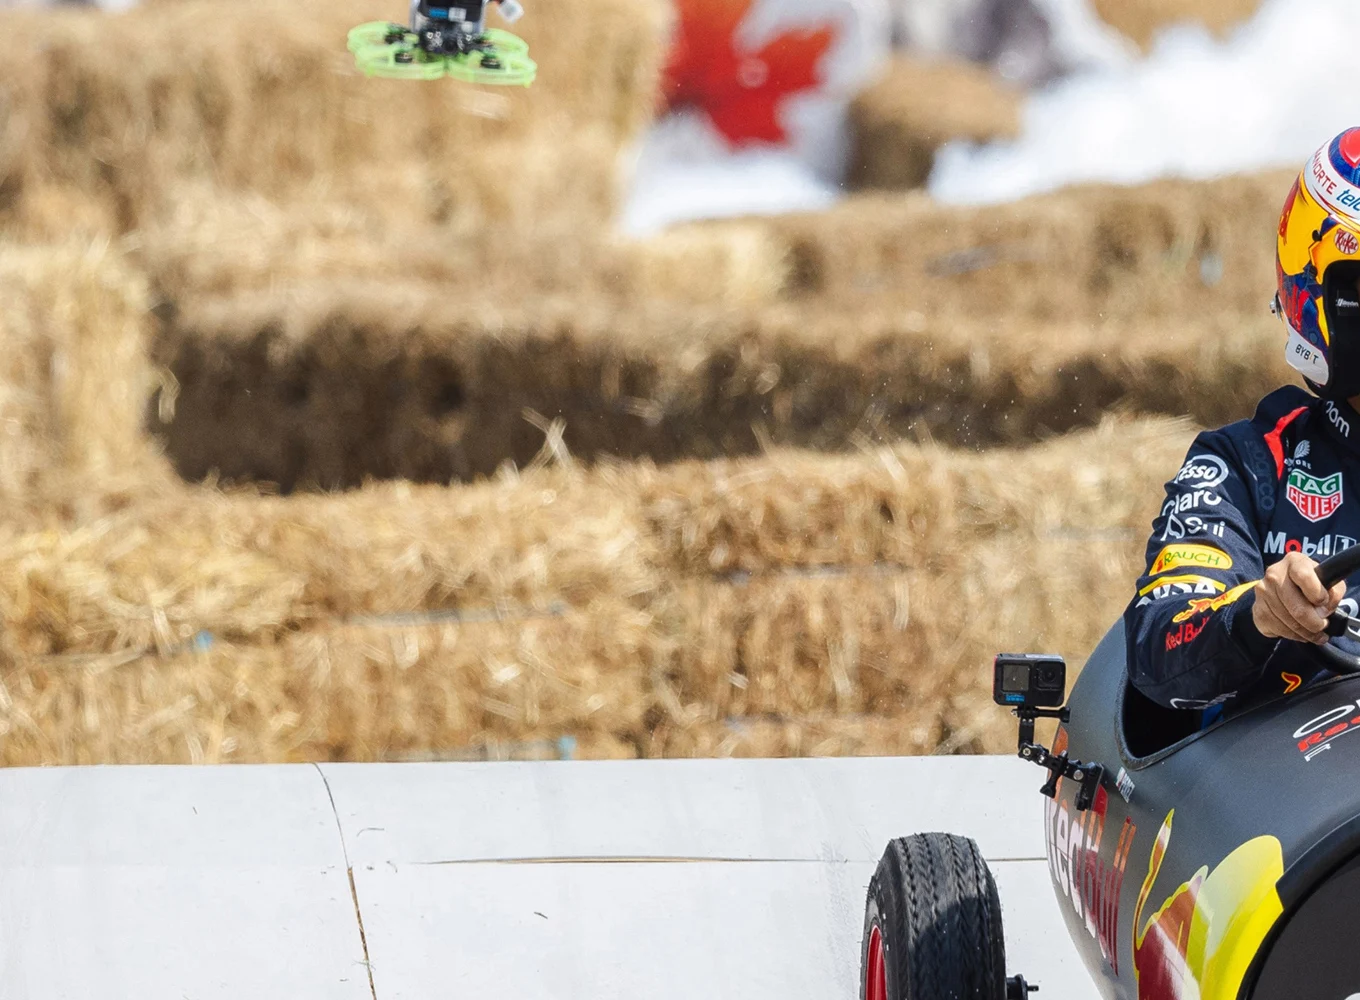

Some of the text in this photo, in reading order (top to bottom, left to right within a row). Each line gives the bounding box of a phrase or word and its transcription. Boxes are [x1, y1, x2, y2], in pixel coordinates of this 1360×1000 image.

[1178, 463, 1219, 482] Esso
[1291, 471, 1337, 495] TAG
[1290, 487, 1340, 519] HEUER
[1264, 530, 1331, 556] Mobil
[1164, 550, 1220, 565] RAUCH
[1165, 624, 1183, 652] Red
